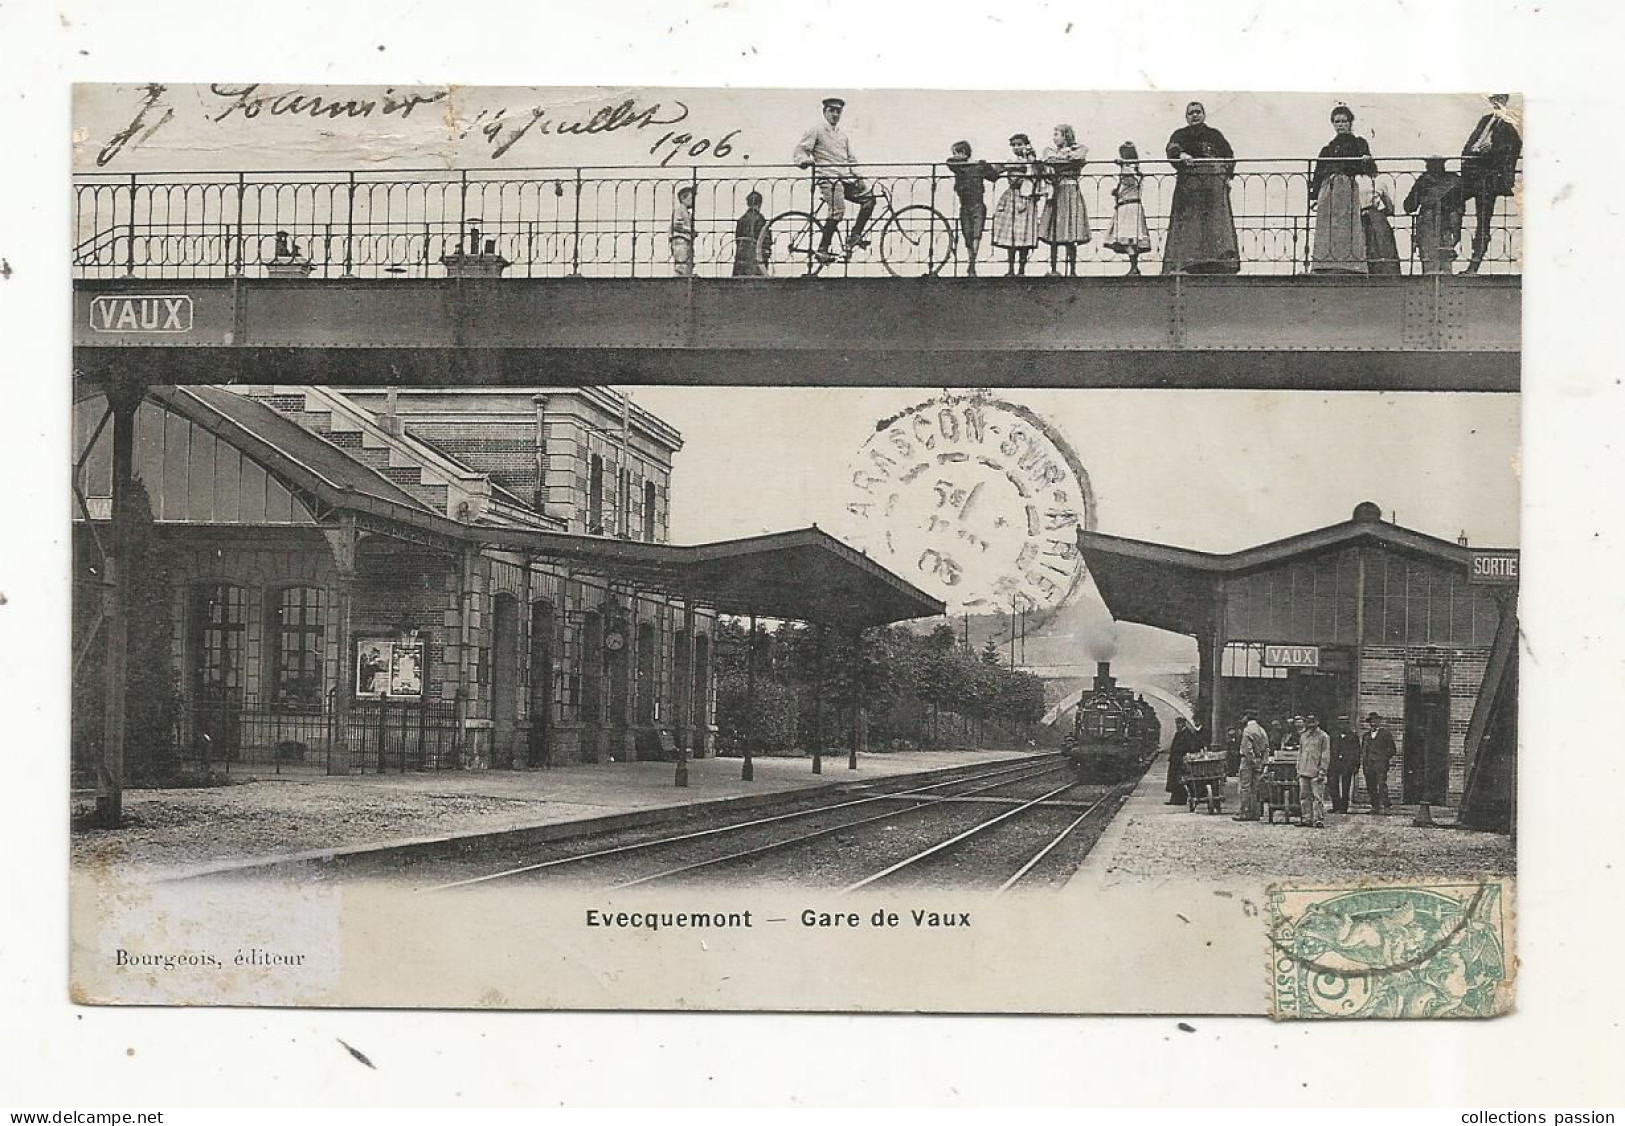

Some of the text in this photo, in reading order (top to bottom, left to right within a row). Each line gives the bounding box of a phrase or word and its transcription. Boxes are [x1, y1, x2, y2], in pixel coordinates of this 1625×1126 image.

[98, 299, 184, 329] VAUX
[1473, 556, 1518, 577] SORTIE
[1270, 649, 1314, 663] VAUX
[587, 910, 753, 931] Evecquemont
[802, 910, 860, 927] Gare
[871, 909, 899, 927] de
[911, 910, 971, 927] Vaux
[116, 949, 305, 971] Bourgeois, éditeur
